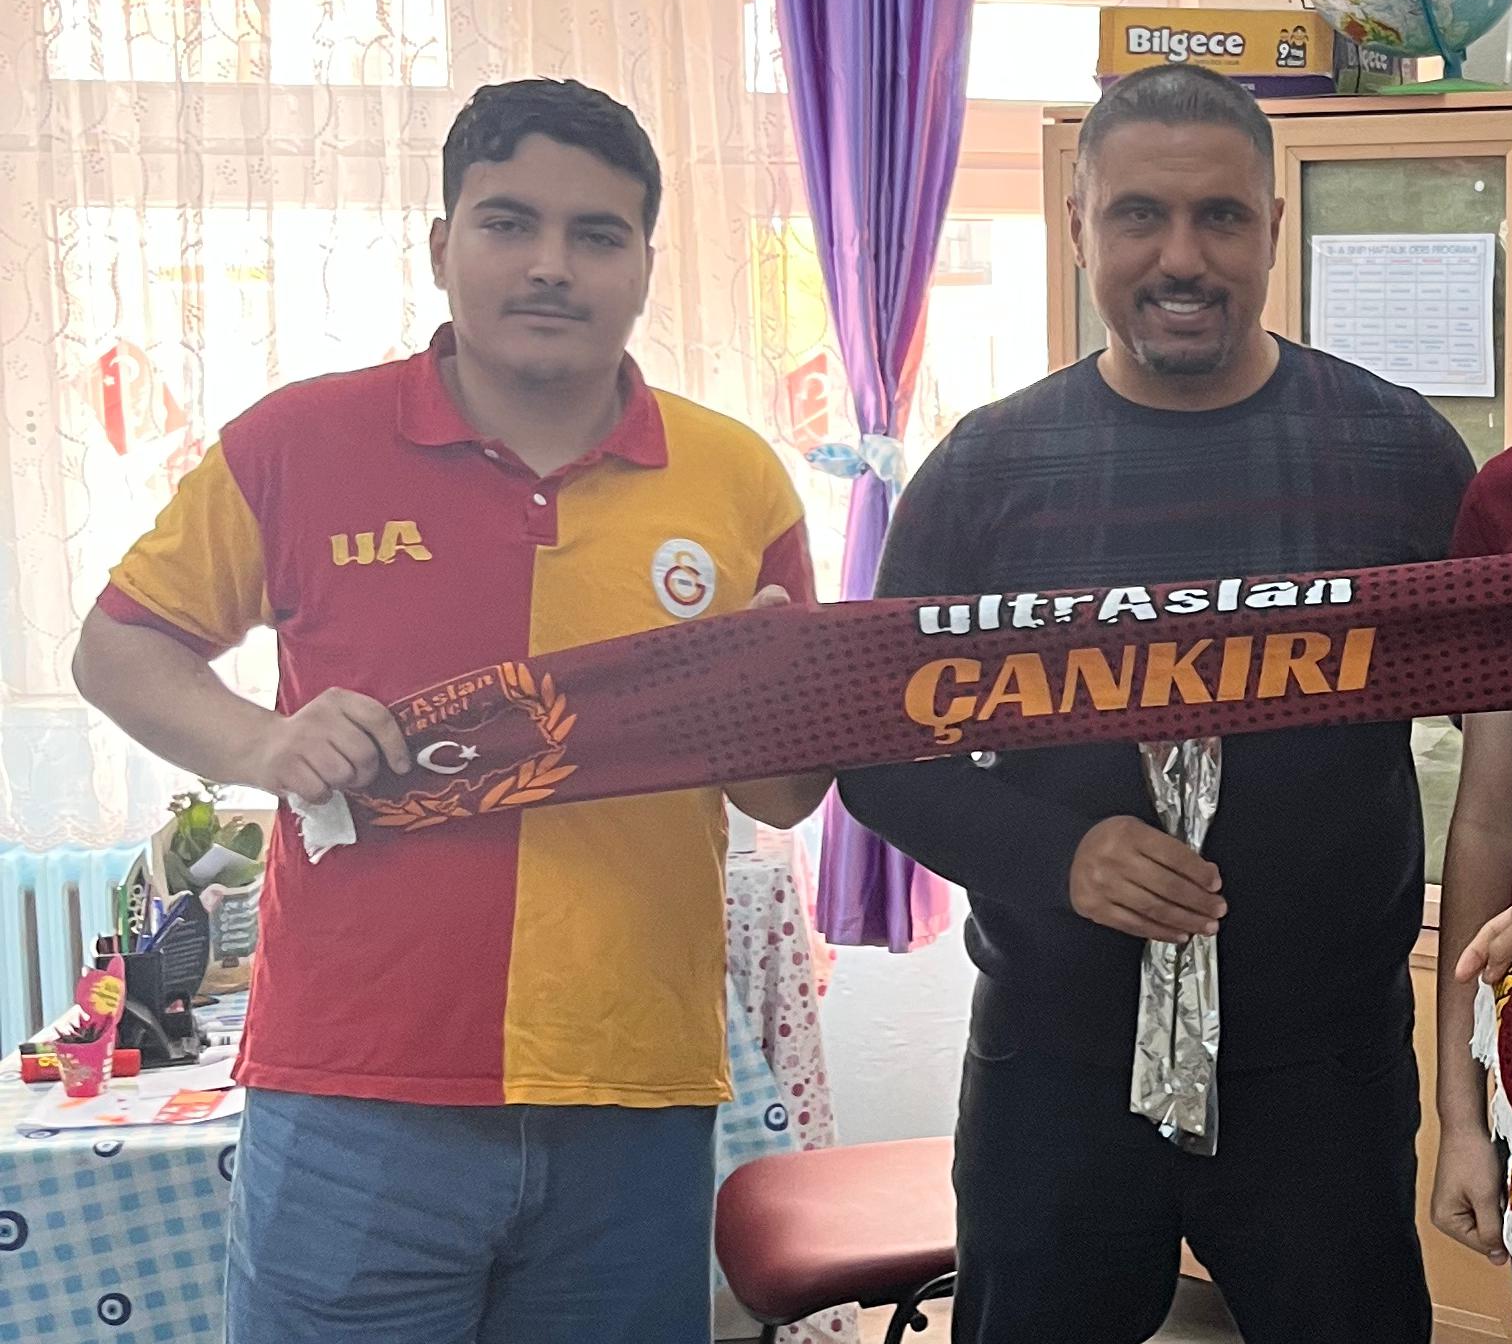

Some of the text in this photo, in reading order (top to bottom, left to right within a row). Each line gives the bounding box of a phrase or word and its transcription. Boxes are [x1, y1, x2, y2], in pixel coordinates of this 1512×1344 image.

[1127, 27, 1245, 61] Bilgece
[1279, 43, 1290, 59] 9
[918, 577, 1352, 635] ultrAslan
[904, 627, 1377, 745] ÇANKIRI
